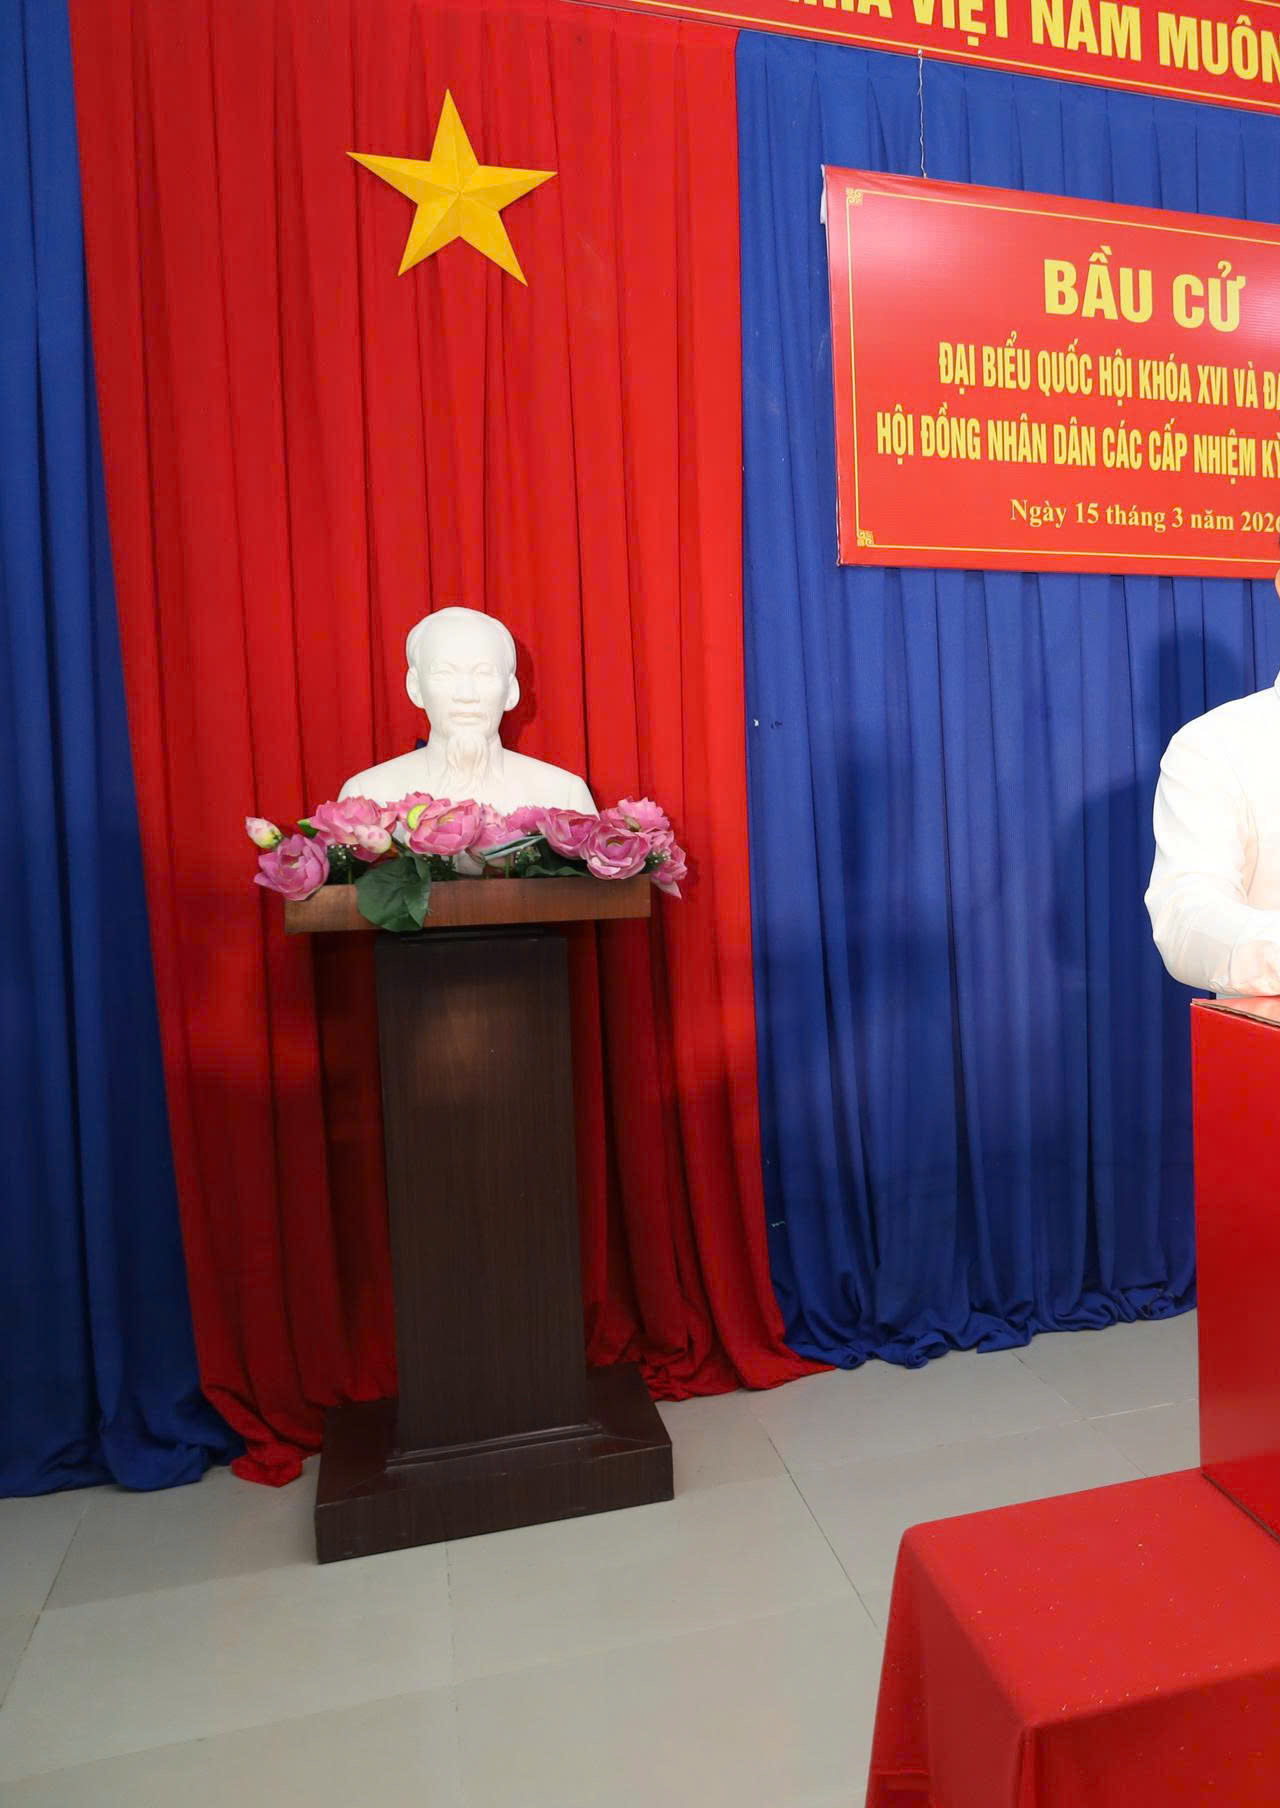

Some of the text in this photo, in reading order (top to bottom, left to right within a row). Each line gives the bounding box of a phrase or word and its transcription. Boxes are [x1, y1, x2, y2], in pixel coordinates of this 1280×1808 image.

[1031, 0, 1142, 62] NAM
[1043, 245, 1247, 333] BẦU CỬ
[938, 341, 976, 395] ĐẠI
[982, 331, 1031, 390] BIỂU
[1037, 338, 1093, 397] QUỐC
[1098, 348, 1133, 407] HỘI
[1138, 352, 1192, 403] KHÓA
[1197, 364, 1229, 406] XVI
[1233, 360, 1259, 409] VÀ
[876, 403, 914, 465] HỘI
[920, 402, 981, 460] ĐỒNG
[987, 412, 1047, 464] NHÂN
[1053, 416, 1096, 467] DÂN
[1102, 419, 1142, 470] CÁC
[1148, 417, 1188, 472] CẤP
[1193, 428, 1257, 485] NHIỆM
[1010, 499, 1067, 528] Ngày
[1075, 502, 1099, 525] 15
[1105, 504, 1166, 533] tháng
[1171, 506, 1184, 528] 3
[1190, 509, 1235, 532] năm
